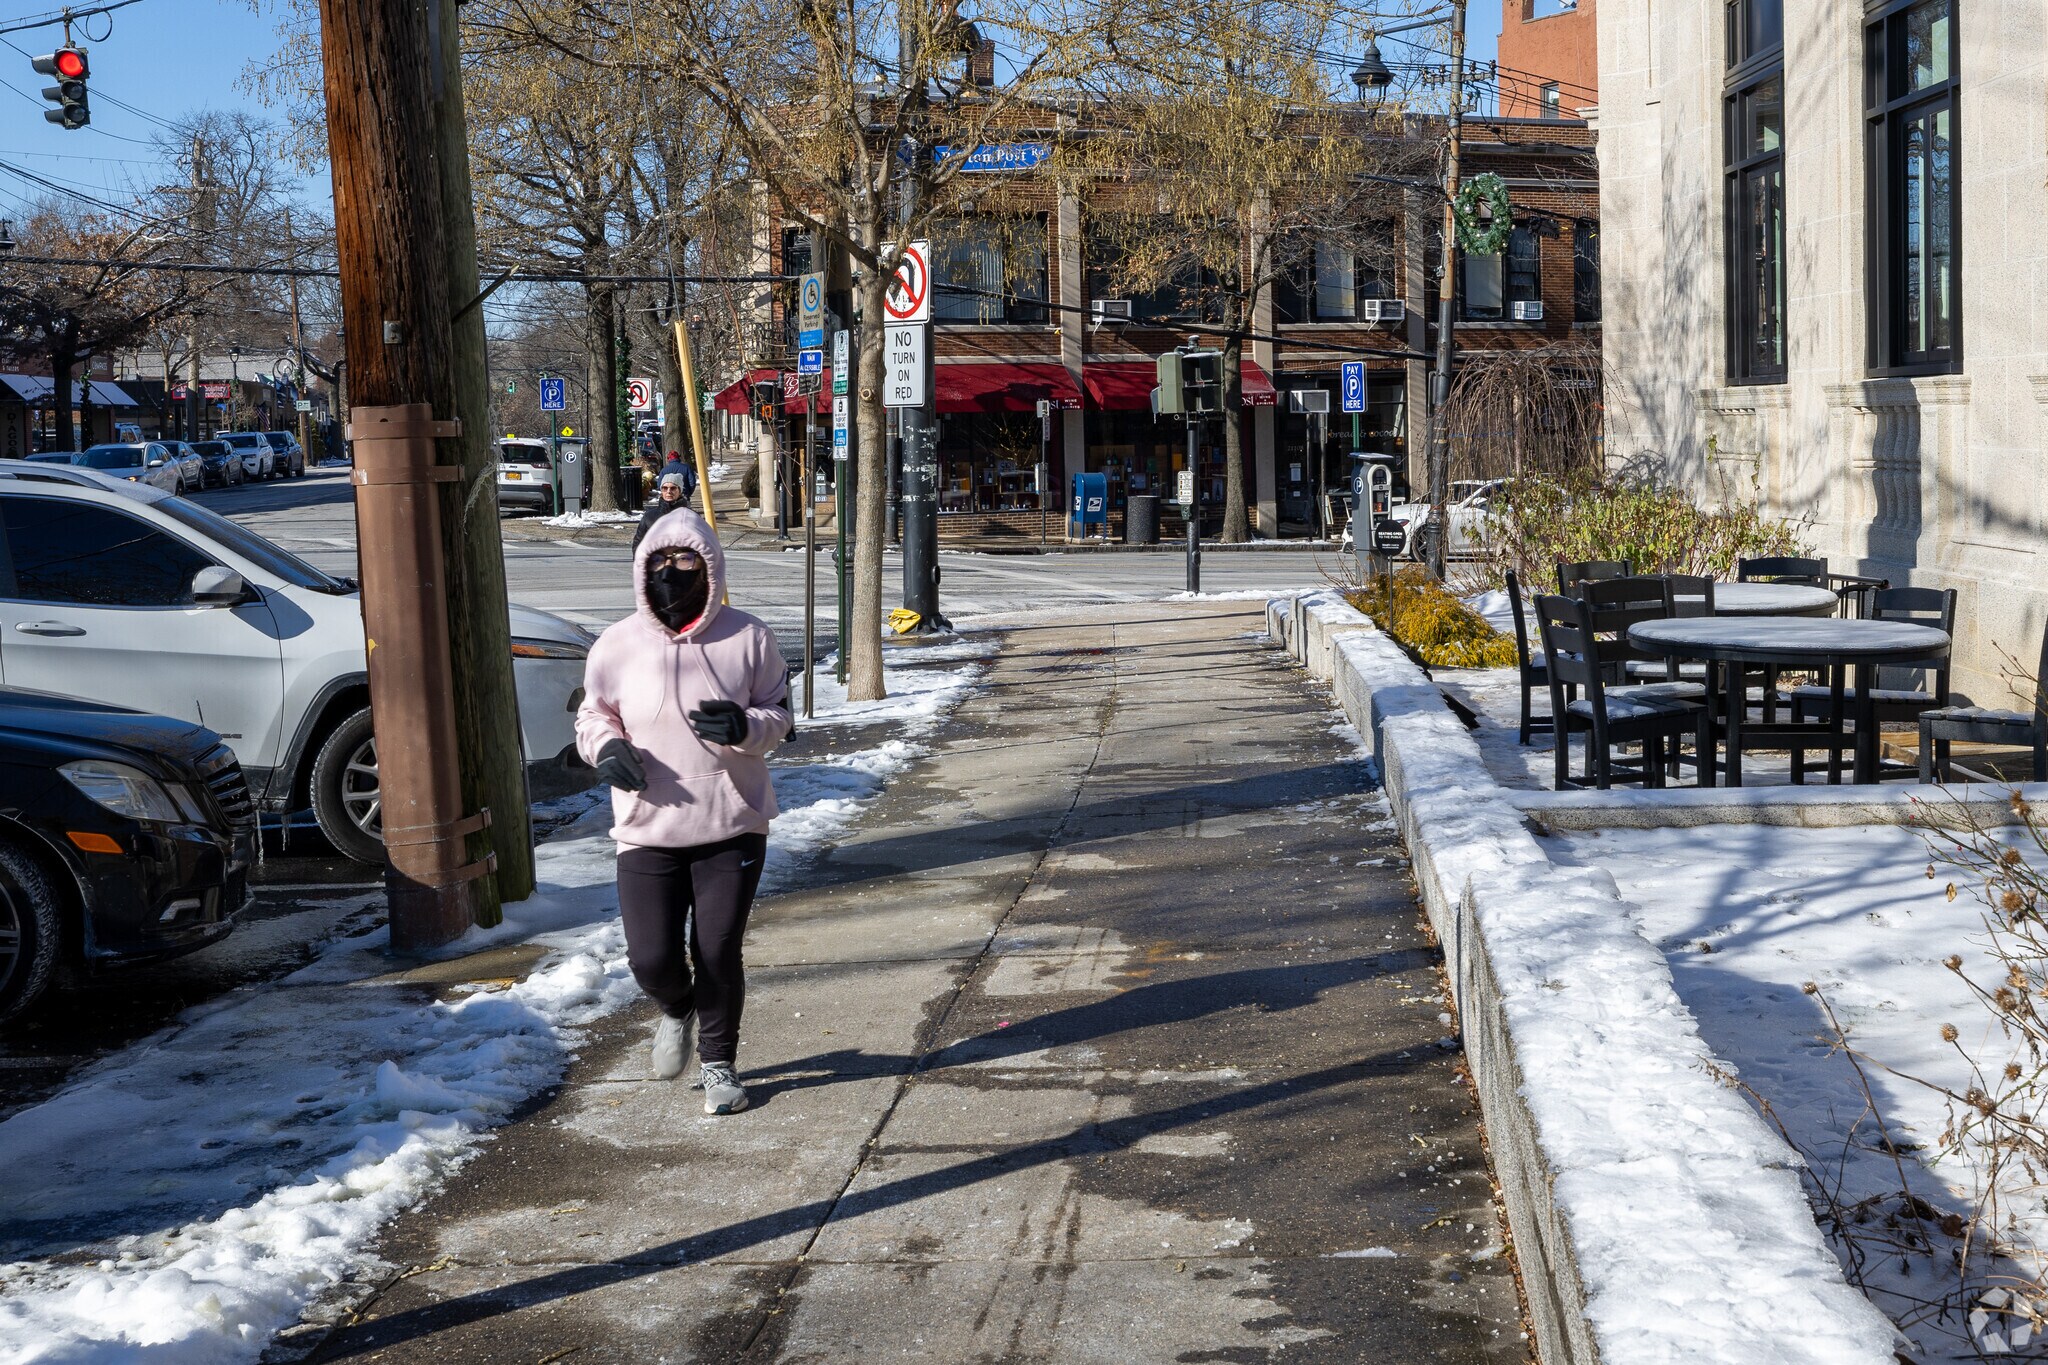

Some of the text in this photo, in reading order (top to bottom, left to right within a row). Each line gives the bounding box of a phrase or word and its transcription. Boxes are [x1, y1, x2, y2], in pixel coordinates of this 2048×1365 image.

[997, 149, 1027, 163] Post
[895, 331, 912, 347] NO
[892, 352, 916, 365] TURN
[897, 369, 910, 382] ON
[1346, 365, 1359, 374] PAY
[895, 386, 913, 400] RED
[1350, 378, 1358, 396] P
[549, 388, 557, 400] P
[1345, 399, 1361, 409] HERE
[1356, 479, 1362, 491] P
